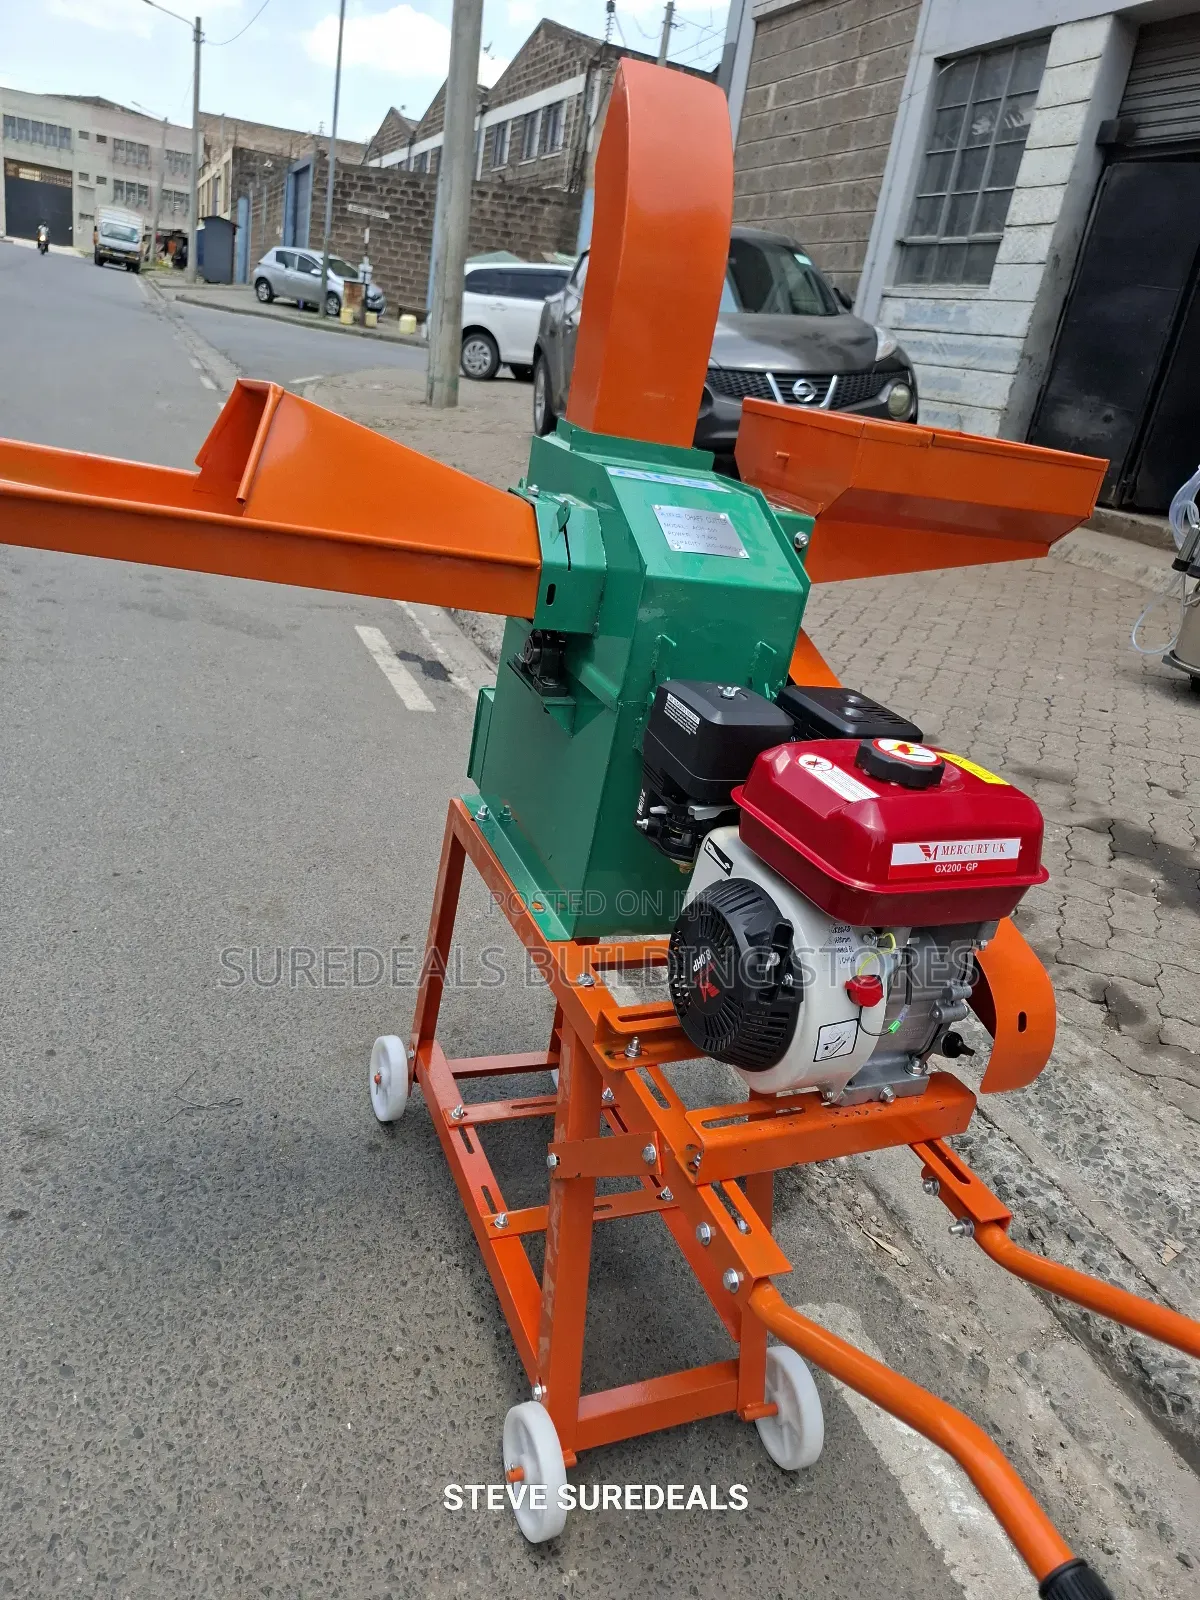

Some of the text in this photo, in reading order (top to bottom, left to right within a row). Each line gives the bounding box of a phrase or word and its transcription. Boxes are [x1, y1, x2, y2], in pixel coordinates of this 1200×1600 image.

[941, 843, 990, 856] MERCURY
[992, 842, 1006, 853] UK
[935, 862, 979, 873] GX200-GP
